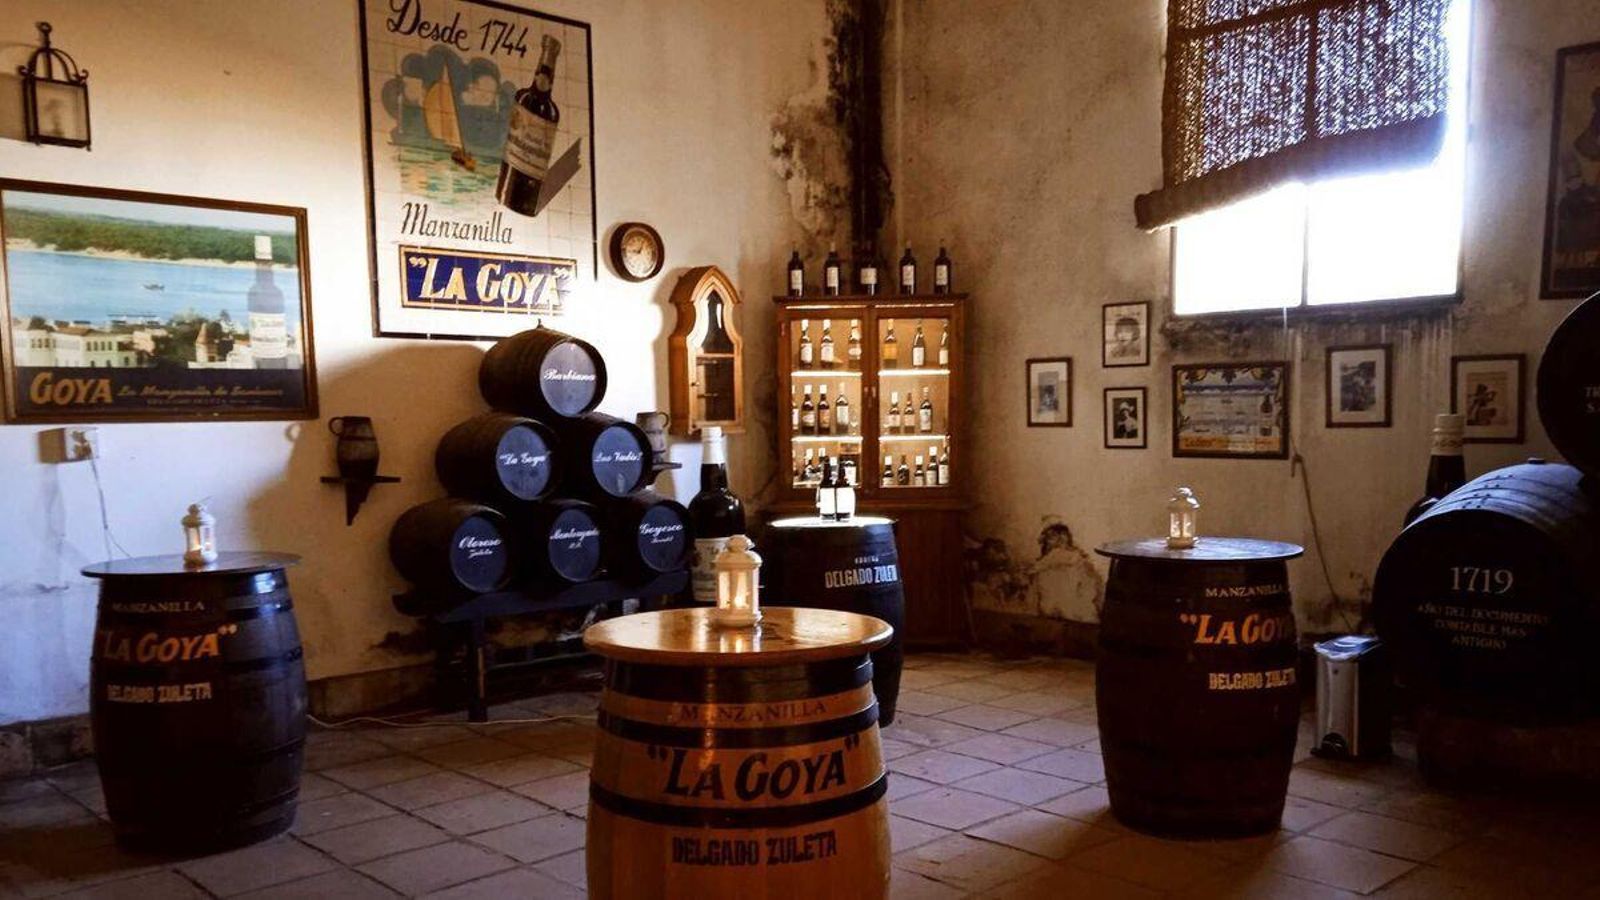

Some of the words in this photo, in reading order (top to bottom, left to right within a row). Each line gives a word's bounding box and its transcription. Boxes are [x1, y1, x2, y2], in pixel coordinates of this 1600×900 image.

[387, 0, 470, 51] Desde
[480, 19, 528, 58] 1744
[401, 202, 513, 244] Manzanilla
[30, 371, 113, 405] GOYA
[824, 567, 873, 589] DELGADO
[1450, 566, 1514, 594] 1719
[1208, 672, 1263, 690] DELGADO
[671, 836, 760, 866] DELGADO
[765, 829, 838, 865] ZULETA
